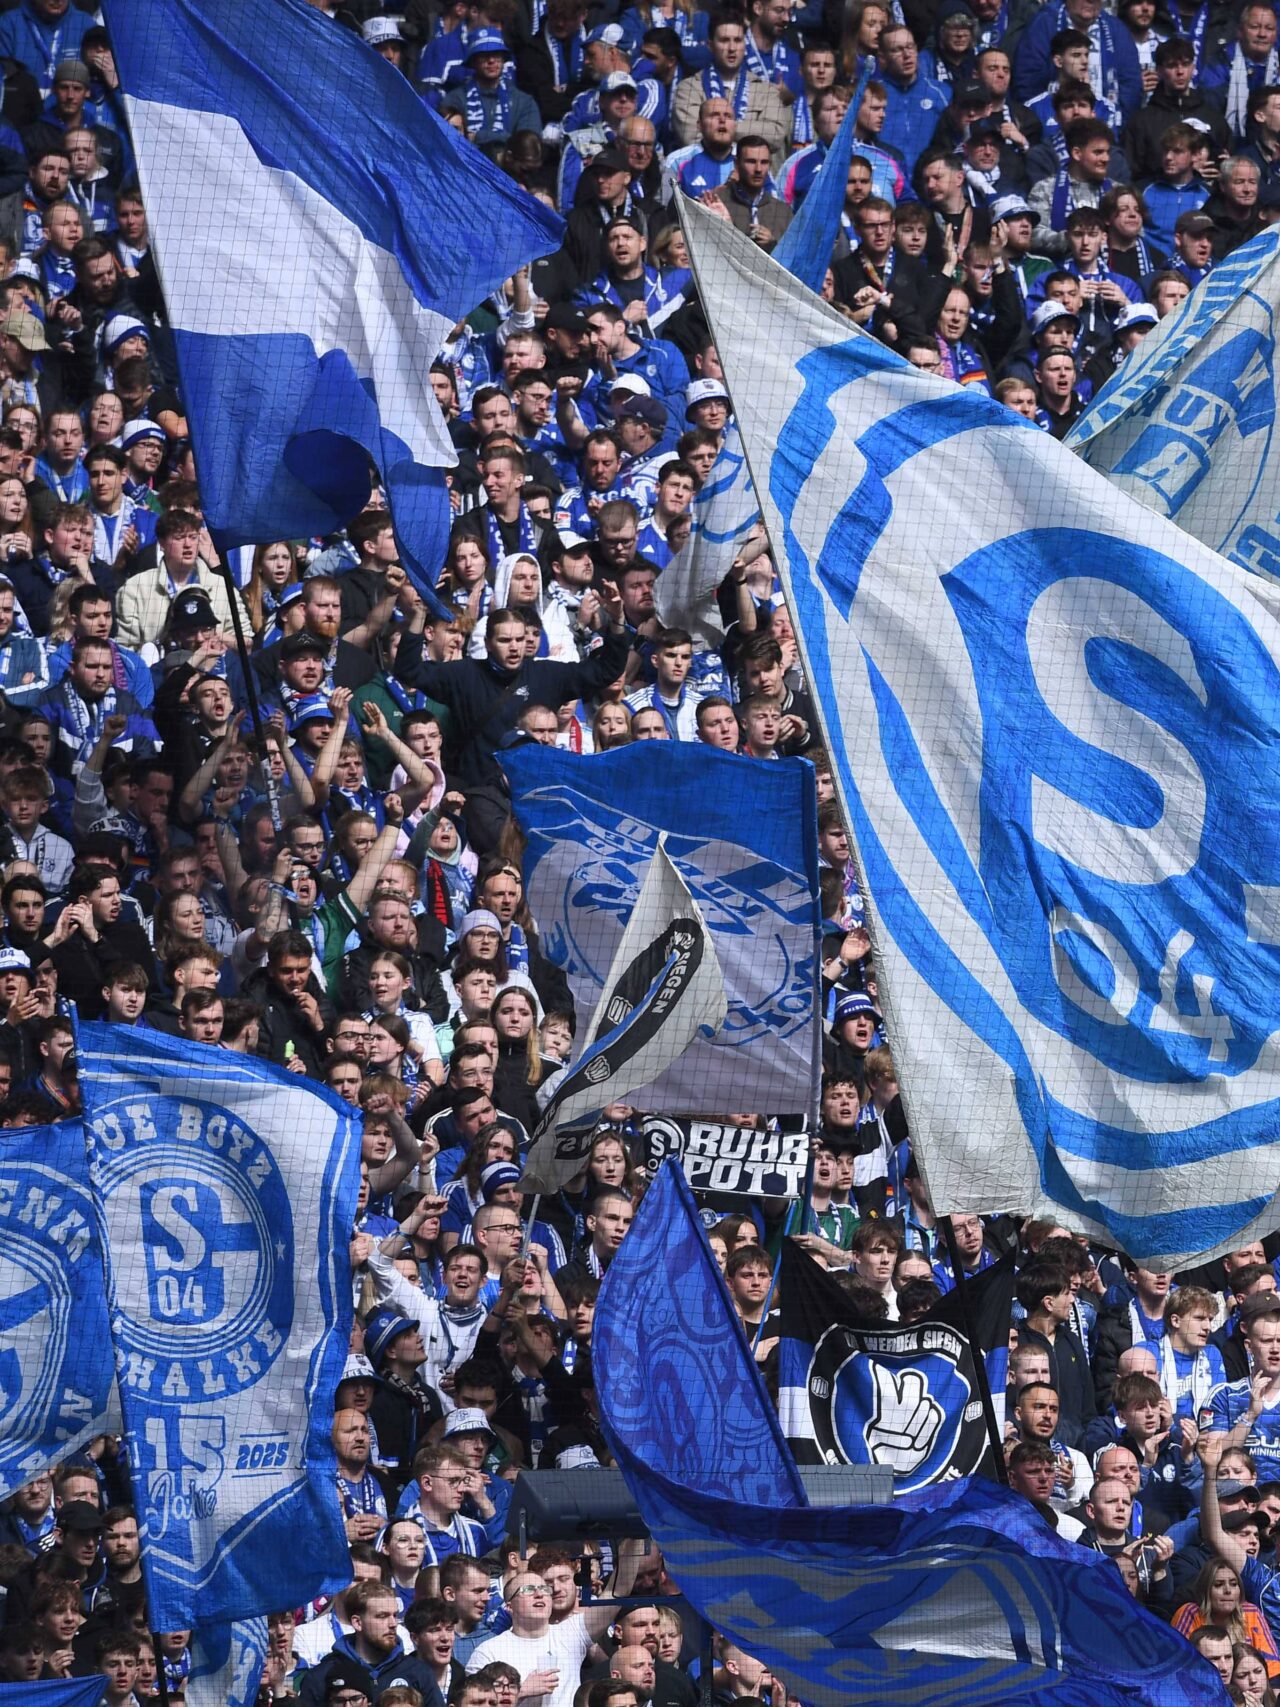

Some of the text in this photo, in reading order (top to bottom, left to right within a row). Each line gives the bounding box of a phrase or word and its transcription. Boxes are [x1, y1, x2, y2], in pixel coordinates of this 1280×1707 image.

[176, 1103, 273, 1190] BOYZ
[685, 1121, 809, 1165] RUHR
[683, 1152, 808, 1197] POTT
[236, 1440, 290, 1470] 2025
